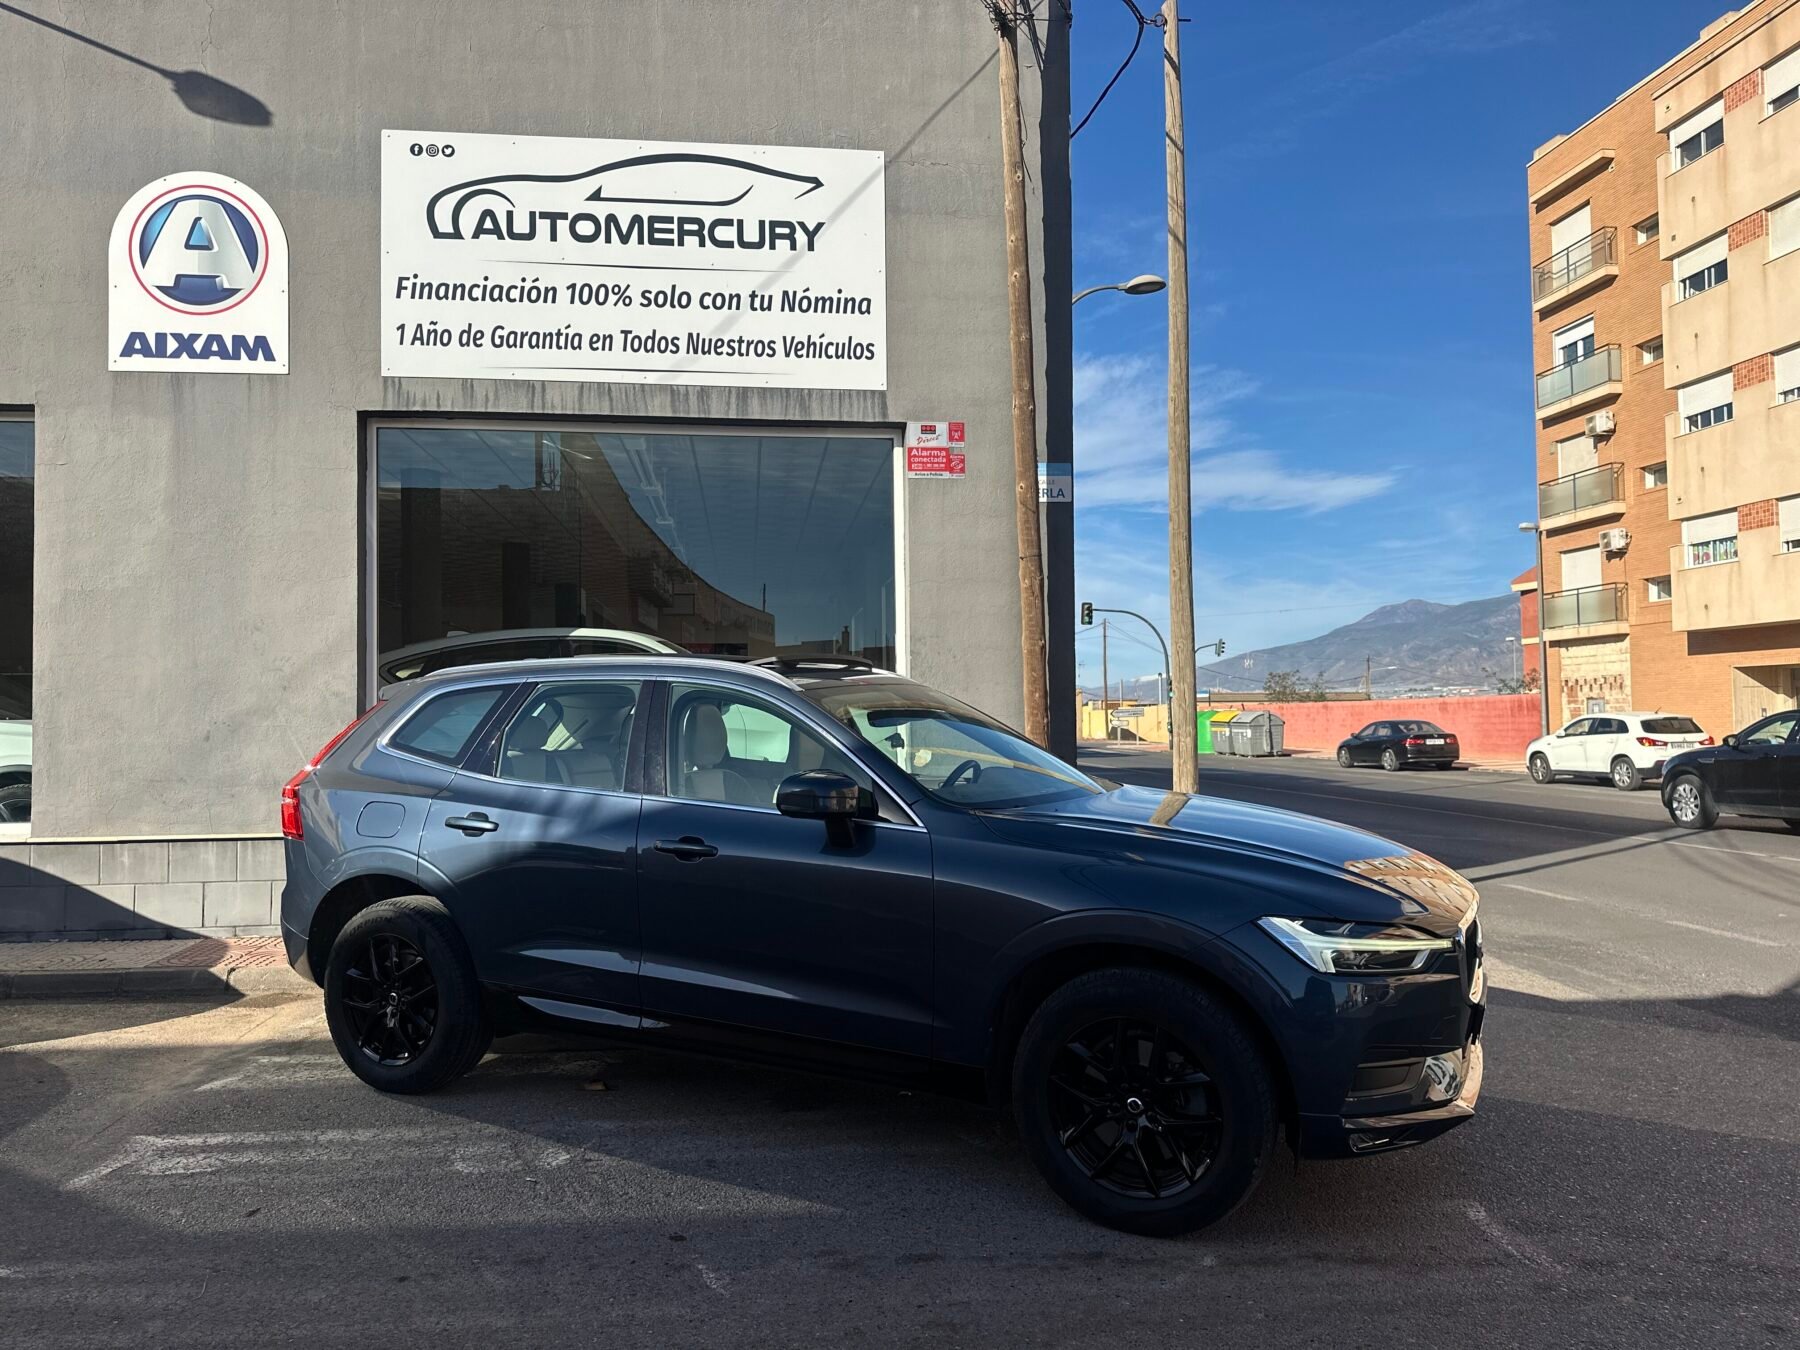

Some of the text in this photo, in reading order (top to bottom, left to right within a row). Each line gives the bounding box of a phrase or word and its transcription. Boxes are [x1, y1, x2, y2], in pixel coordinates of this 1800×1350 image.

[471, 208, 826, 252] AUTOMERCURY
[395, 275, 872, 316] Financiación 100% solo con tu Nómina
[119, 331, 277, 362] AIXAM
[396, 320, 875, 361] 1 Año de Garantía en Todos Nuestros Vehículos
[910, 448, 946, 456] Alarma
